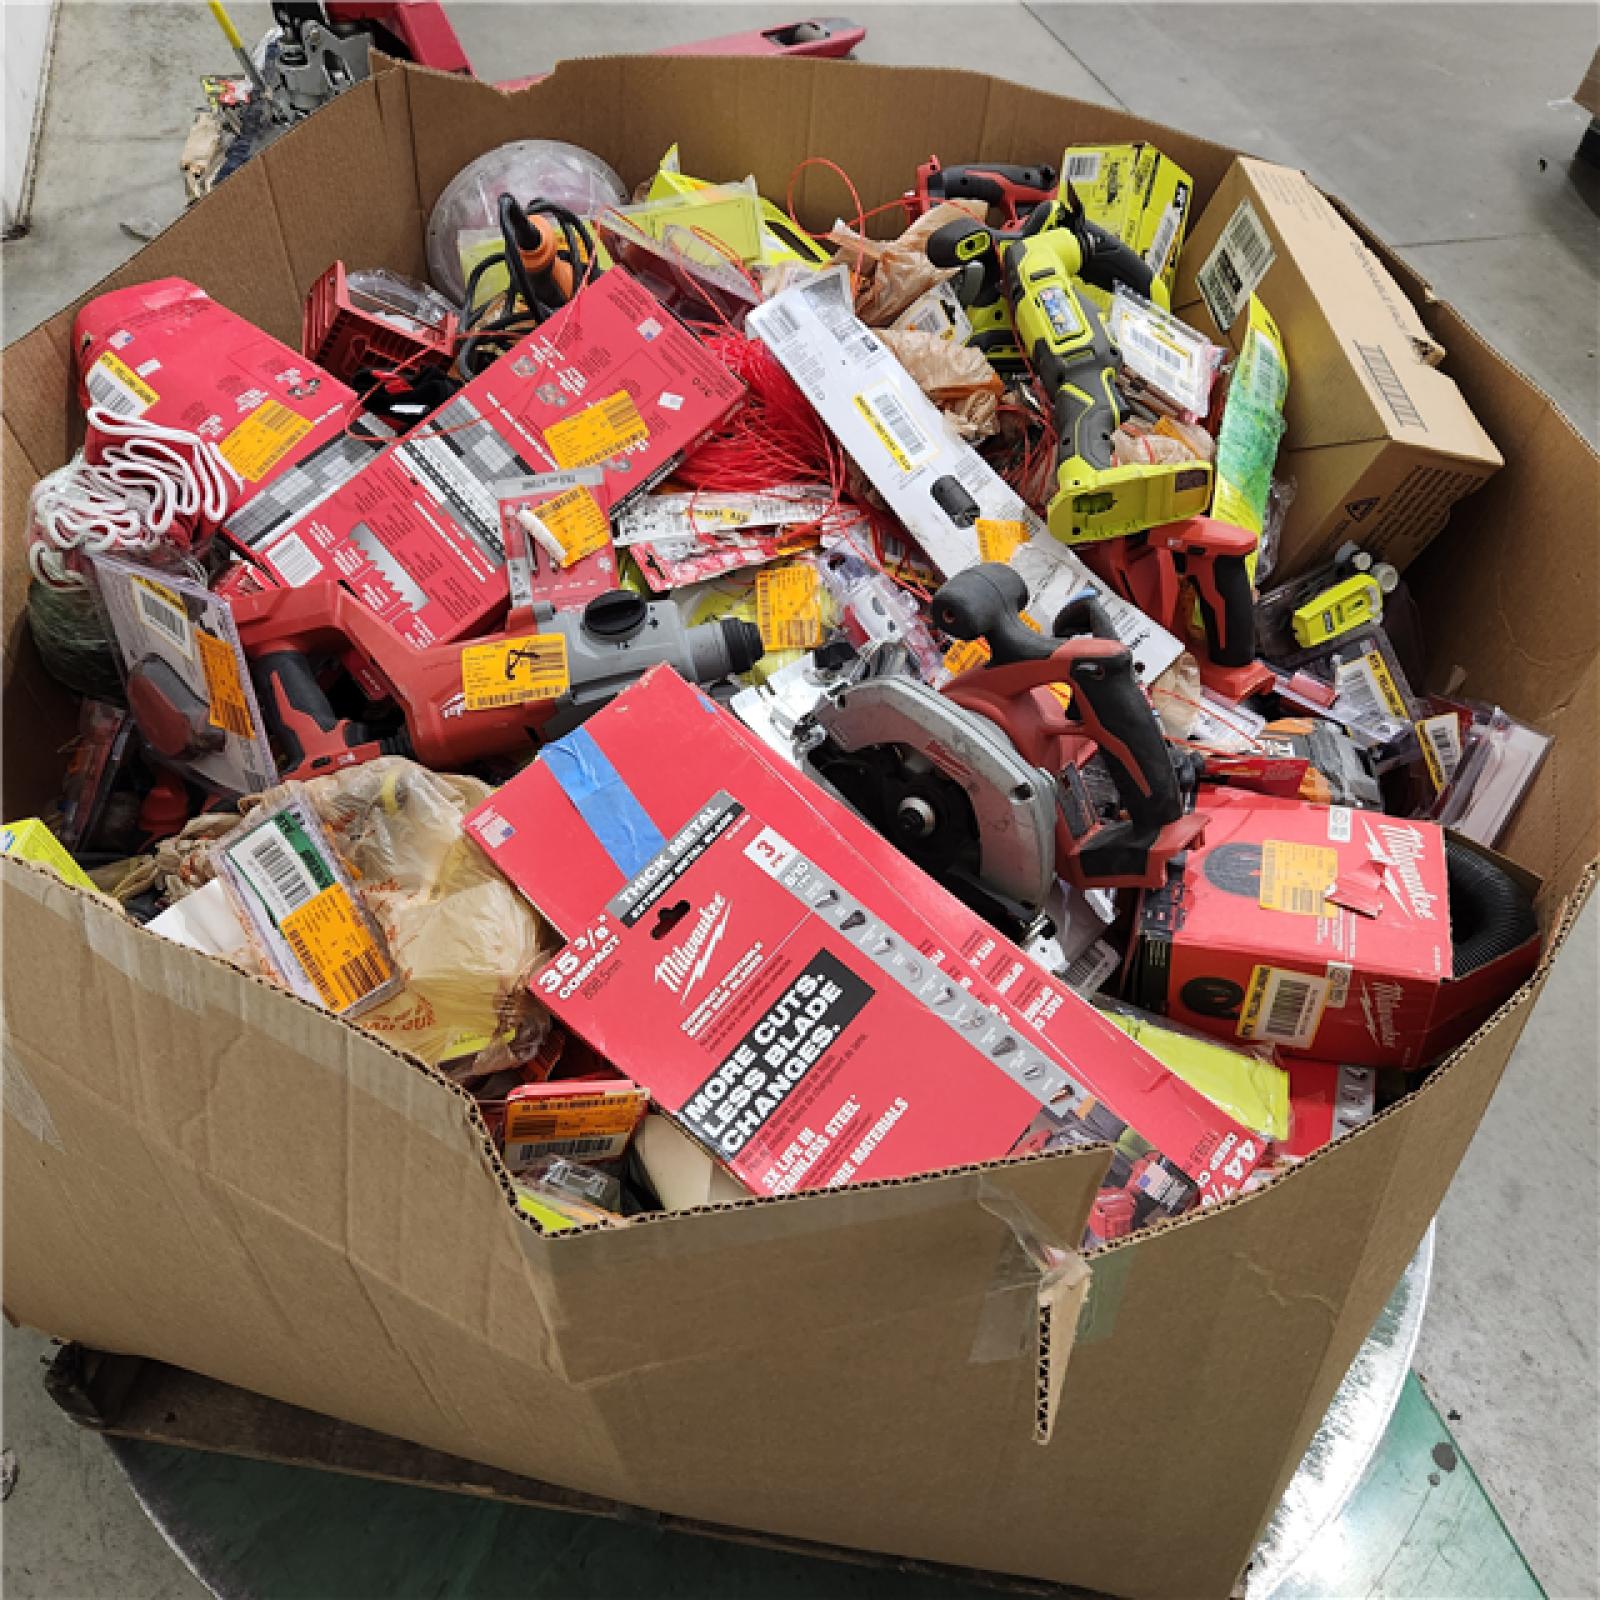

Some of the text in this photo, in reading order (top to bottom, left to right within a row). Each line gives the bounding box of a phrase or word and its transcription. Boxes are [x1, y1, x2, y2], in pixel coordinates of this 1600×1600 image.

[619, 854, 671, 903] THICK
[668, 807, 721, 856] METAL
[630, 873, 676, 918] EXTREME
[674, 845, 705, 873] METAL
[757, 839, 777, 859] 3
[1377, 823, 1438, 920] Milwaukee
[537, 950, 580, 993] 35
[559, 934, 621, 999] COMPACT
[654, 890, 726, 993] Milwaukee
[679, 940, 764, 1031] COMPACT PORTABLE
[687, 953, 764, 1036] BAND SAW BLADES
[1371, 980, 1404, 1049] Milwaukee
[684, 1043, 758, 1122] MORE
[754, 973, 826, 1045] CUTS.
[701, 1067, 768, 1138] LESS
[762, 978, 844, 1069] BLADE
[721, 1024, 842, 1152] CHANGES.
[761, 1126, 816, 1189] 3X LIFE IN
[849, 1097, 910, 1165] MATERIALS
[1209, 1132, 1238, 1172] DEEP
[1224, 1139, 1256, 1181] 44
